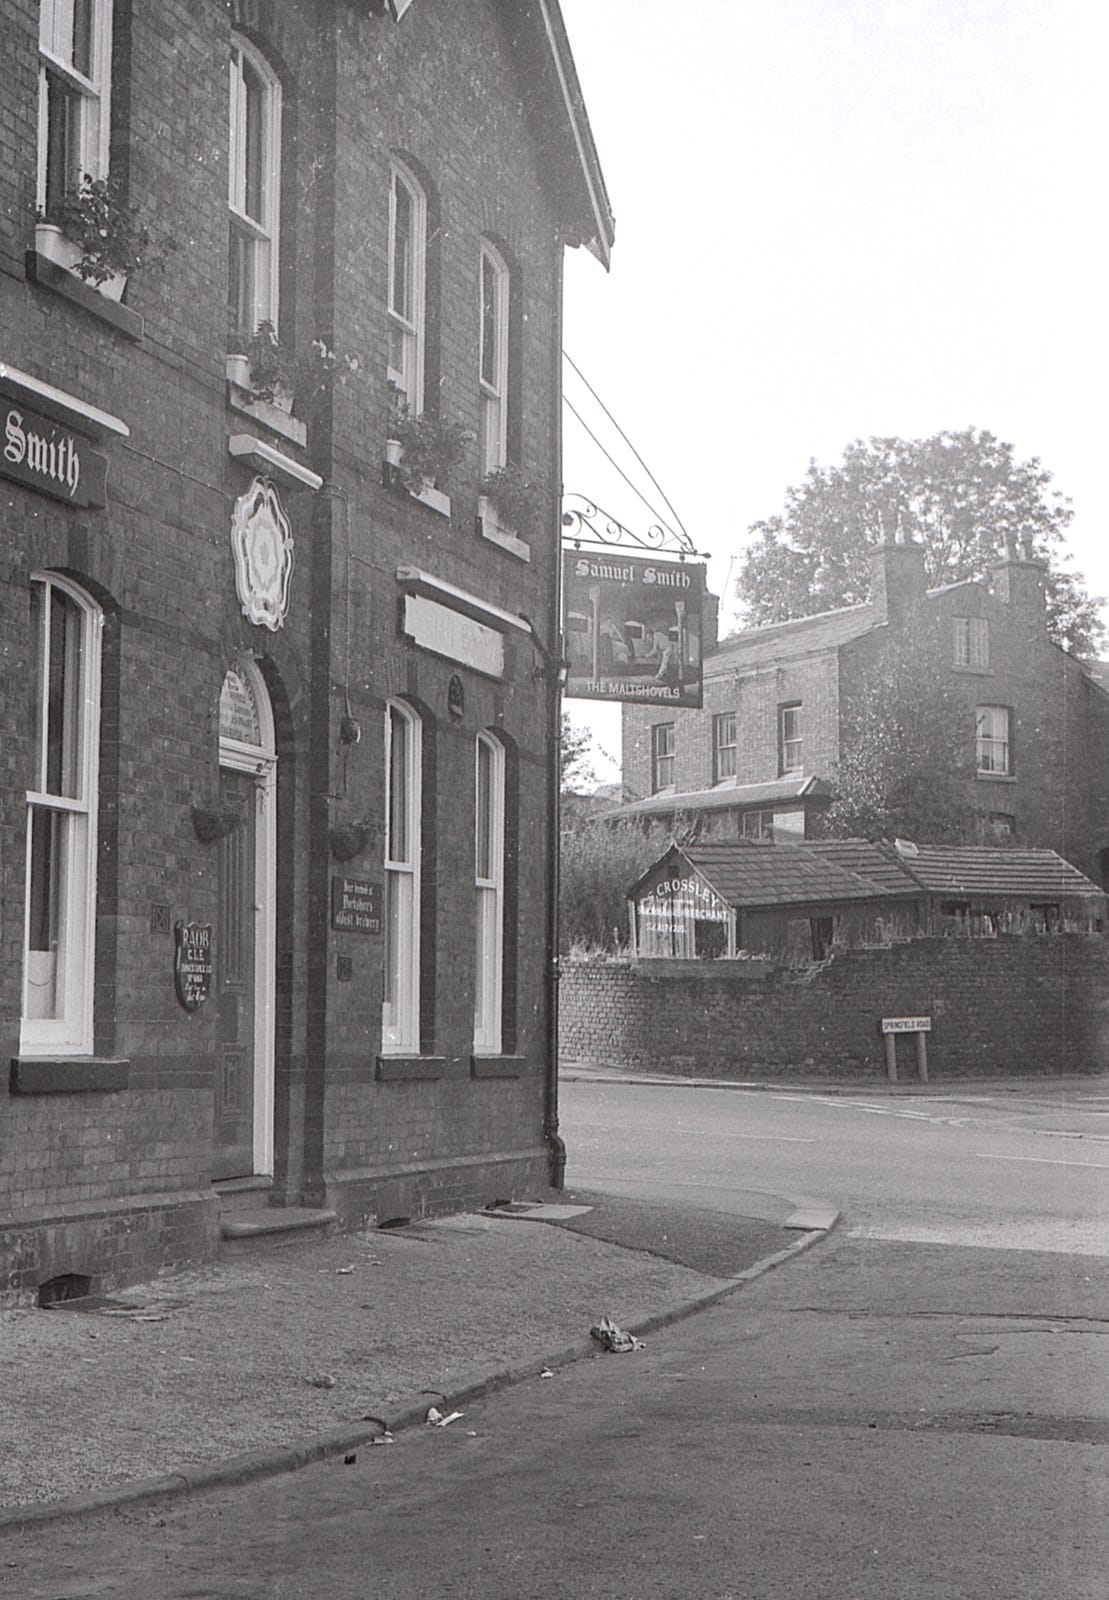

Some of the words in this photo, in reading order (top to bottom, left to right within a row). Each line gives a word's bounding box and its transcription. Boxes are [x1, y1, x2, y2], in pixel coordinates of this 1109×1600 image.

[4, 410, 80, 497] Smith
[575, 559, 634, 582] Samuel
[642, 567, 691, 588] Smith
[586, 681, 606, 693] THE
[609, 683, 680, 698] MALTSHOVELS
[656, 879, 719, 908] CROSSLEY
[917, 1019, 930, 1028] ROAD
